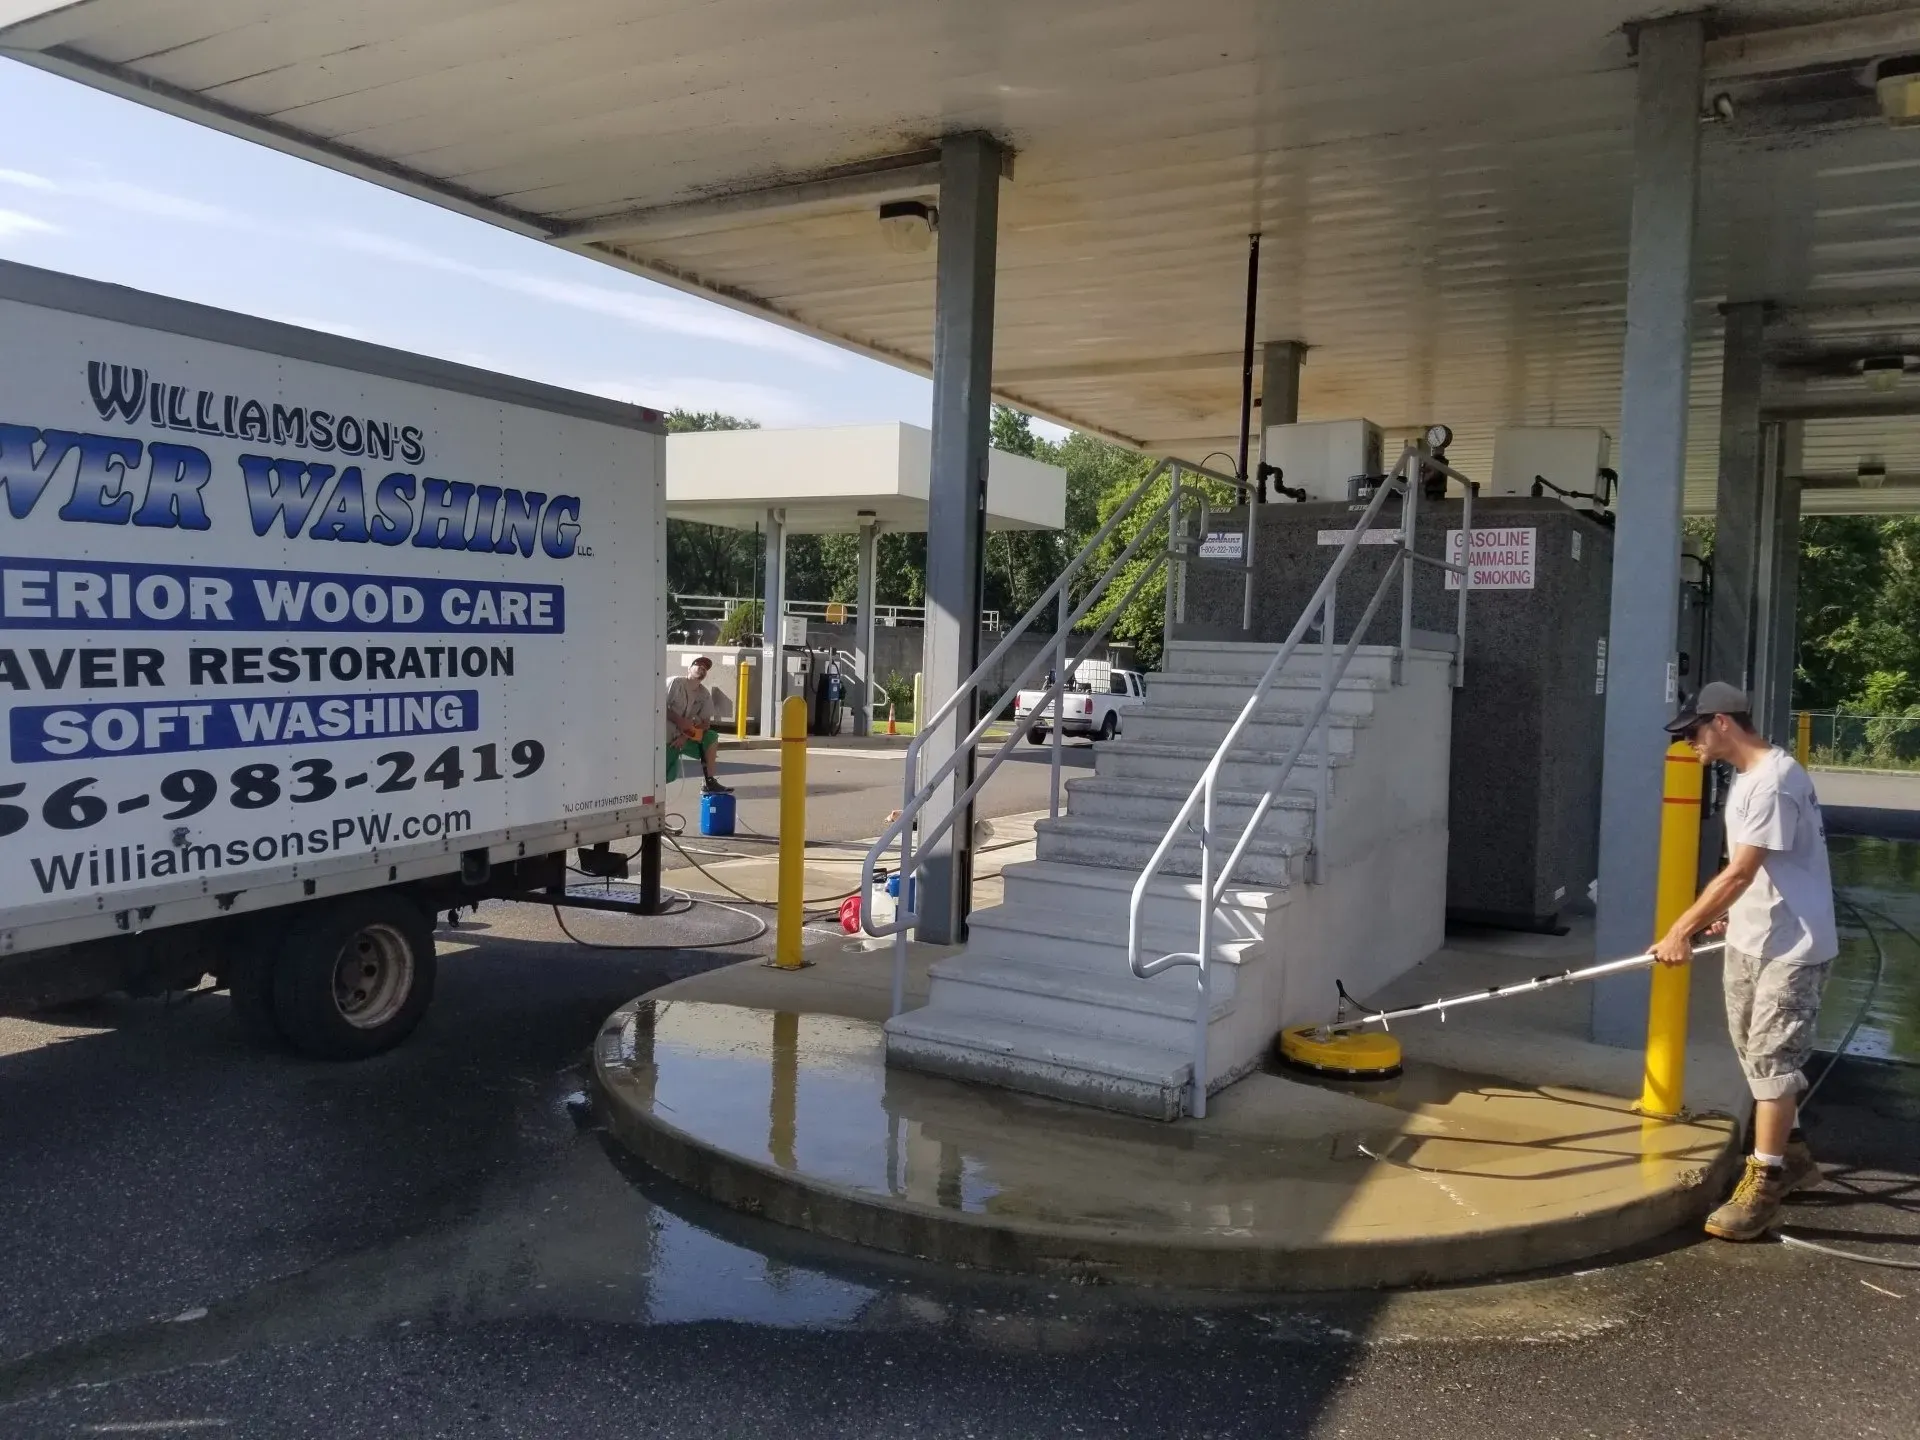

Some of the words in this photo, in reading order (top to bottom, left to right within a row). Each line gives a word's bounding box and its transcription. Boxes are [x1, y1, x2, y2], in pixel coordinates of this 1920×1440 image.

[238, 453, 581, 559] WASHING
[1454, 551, 1529, 566] FAMMABLE
[1473, 570, 1530, 584] SMOKING
[3, 569, 234, 620] ERIOR
[253, 580, 424, 625] WOOD
[440, 591, 554, 626] CARE
[189, 646, 514, 685] RESTORATION
[42, 704, 212, 754] SOFT
[234, 696, 464, 742] WASHING
[575, 801, 594, 811] CONT
[30, 806, 471, 893] WilliamsonsPW.com
